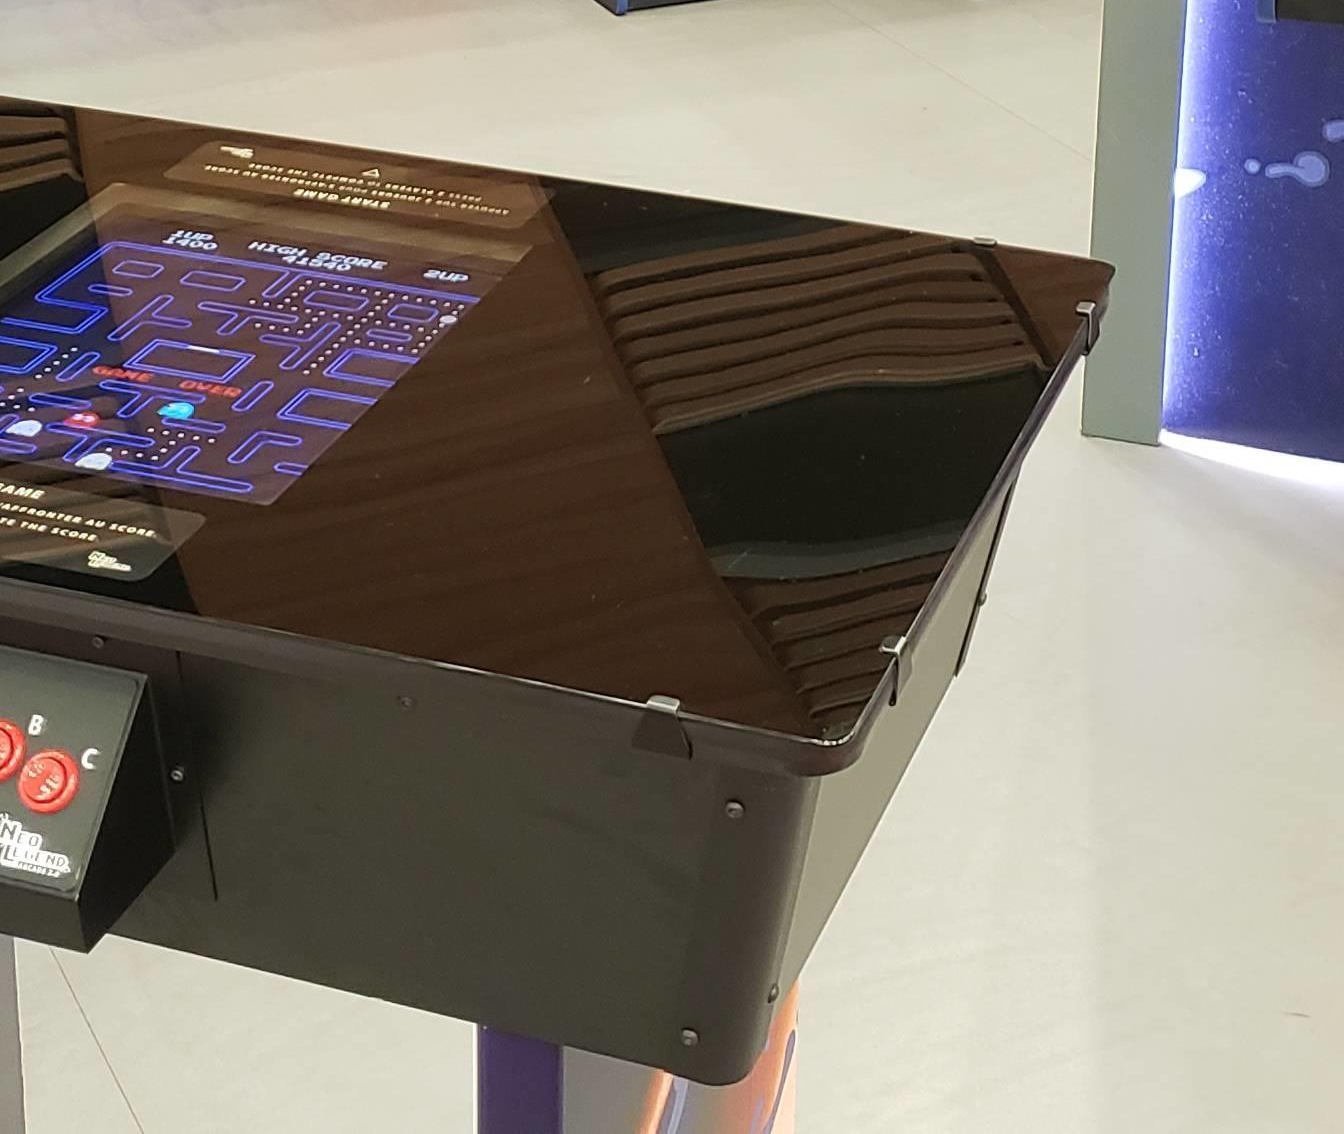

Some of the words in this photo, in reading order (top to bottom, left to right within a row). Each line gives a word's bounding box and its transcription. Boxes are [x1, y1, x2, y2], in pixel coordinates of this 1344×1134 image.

[293, 187, 341, 203] GAME
[341, 195, 392, 210] START
[161, 235, 218, 251] 1400
[170, 229, 214, 242] 1UP
[248, 240, 306, 257] HIGH
[317, 252, 388, 271] SCORE
[422, 268, 470, 283] 2UP
[92, 365, 155, 384] GAME
[179, 378, 244, 399] OVER
[19, 520, 48, 533] THE
[85, 518, 106, 528] AU
[28, 714, 44, 736] B
[81, 748, 100, 770] C
[1, 842, 69, 868] LEGEND
